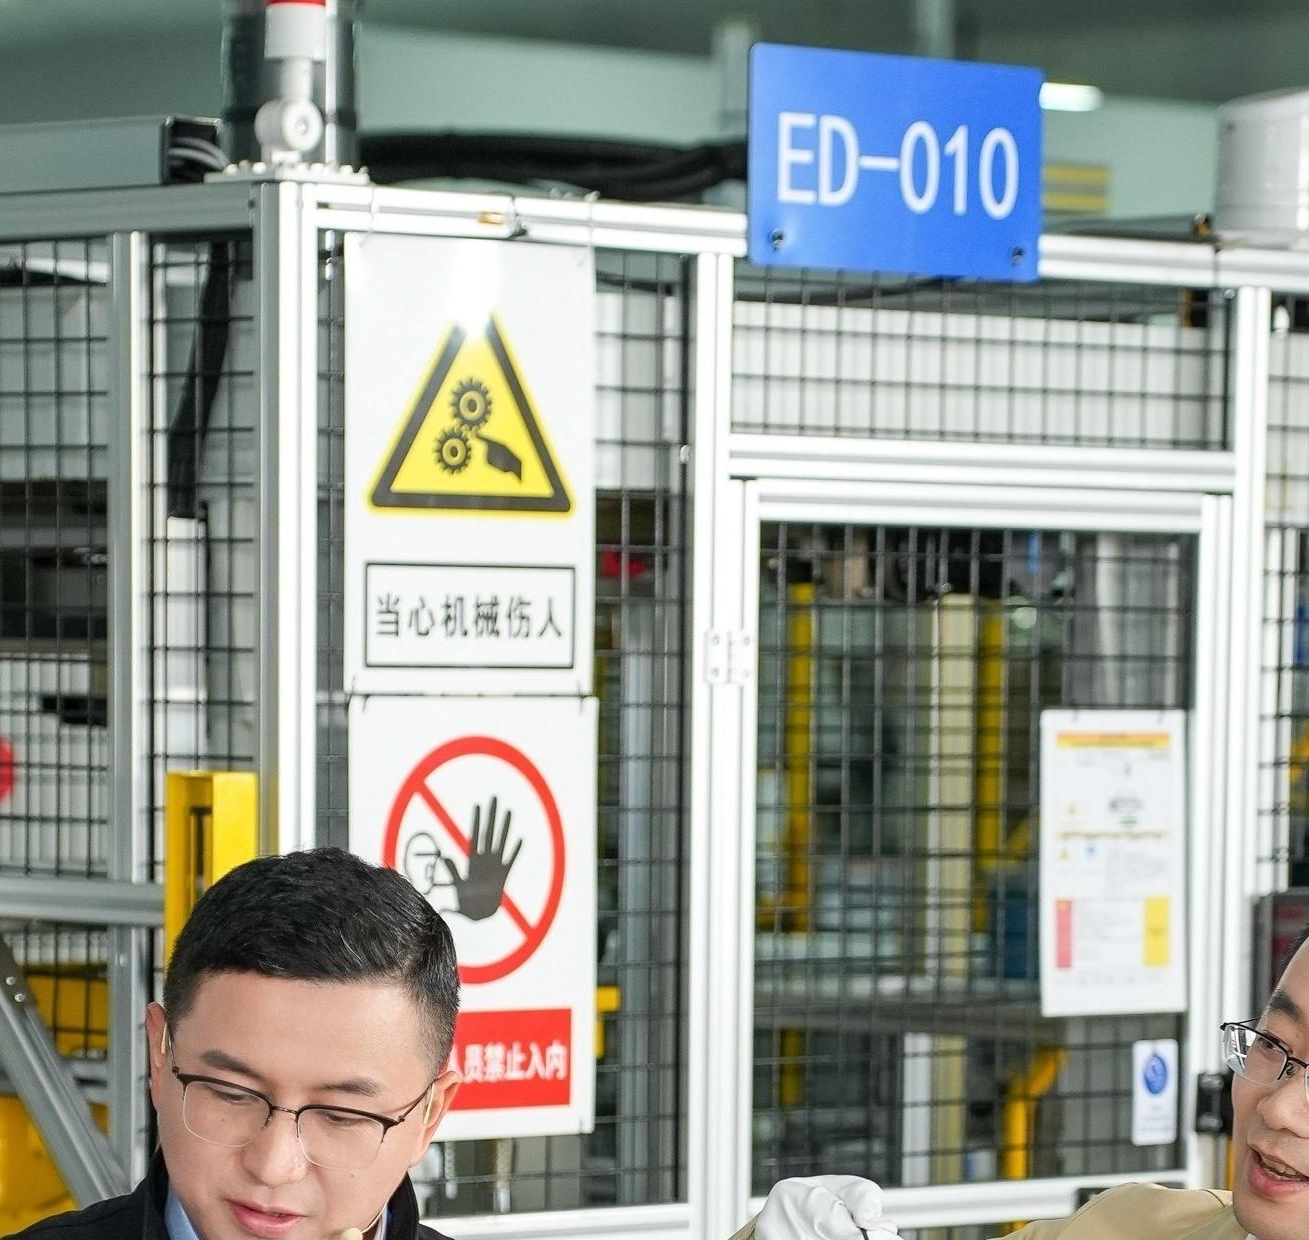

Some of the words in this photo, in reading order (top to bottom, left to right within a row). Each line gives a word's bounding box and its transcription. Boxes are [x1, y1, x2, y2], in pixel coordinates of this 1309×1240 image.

[777, 111, 1019, 221] ED-010
[376, 590, 563, 639] 当心机械伤人
